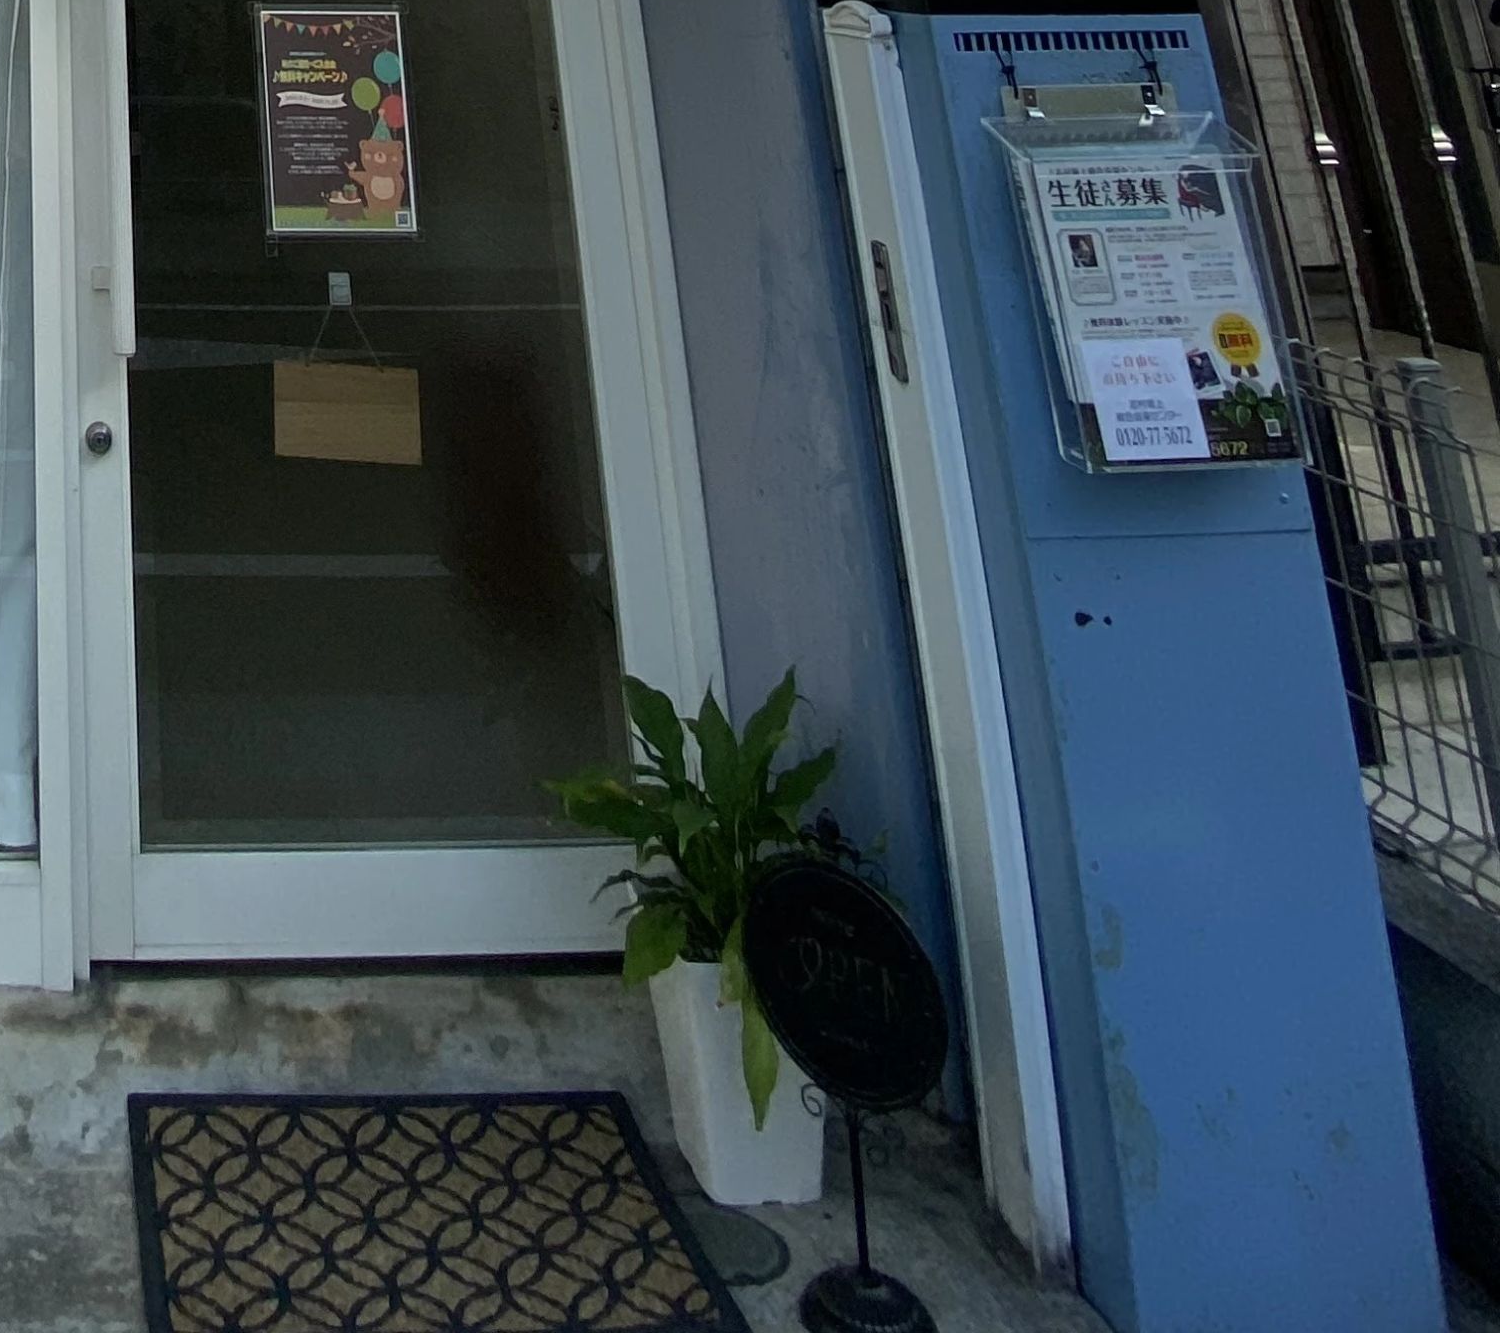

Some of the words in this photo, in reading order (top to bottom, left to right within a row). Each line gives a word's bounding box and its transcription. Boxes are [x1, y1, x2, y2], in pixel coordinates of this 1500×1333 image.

[1047, 177, 1169, 207] 生徒さん募集
[1115, 426, 1194, 446] 0120-77-5672
